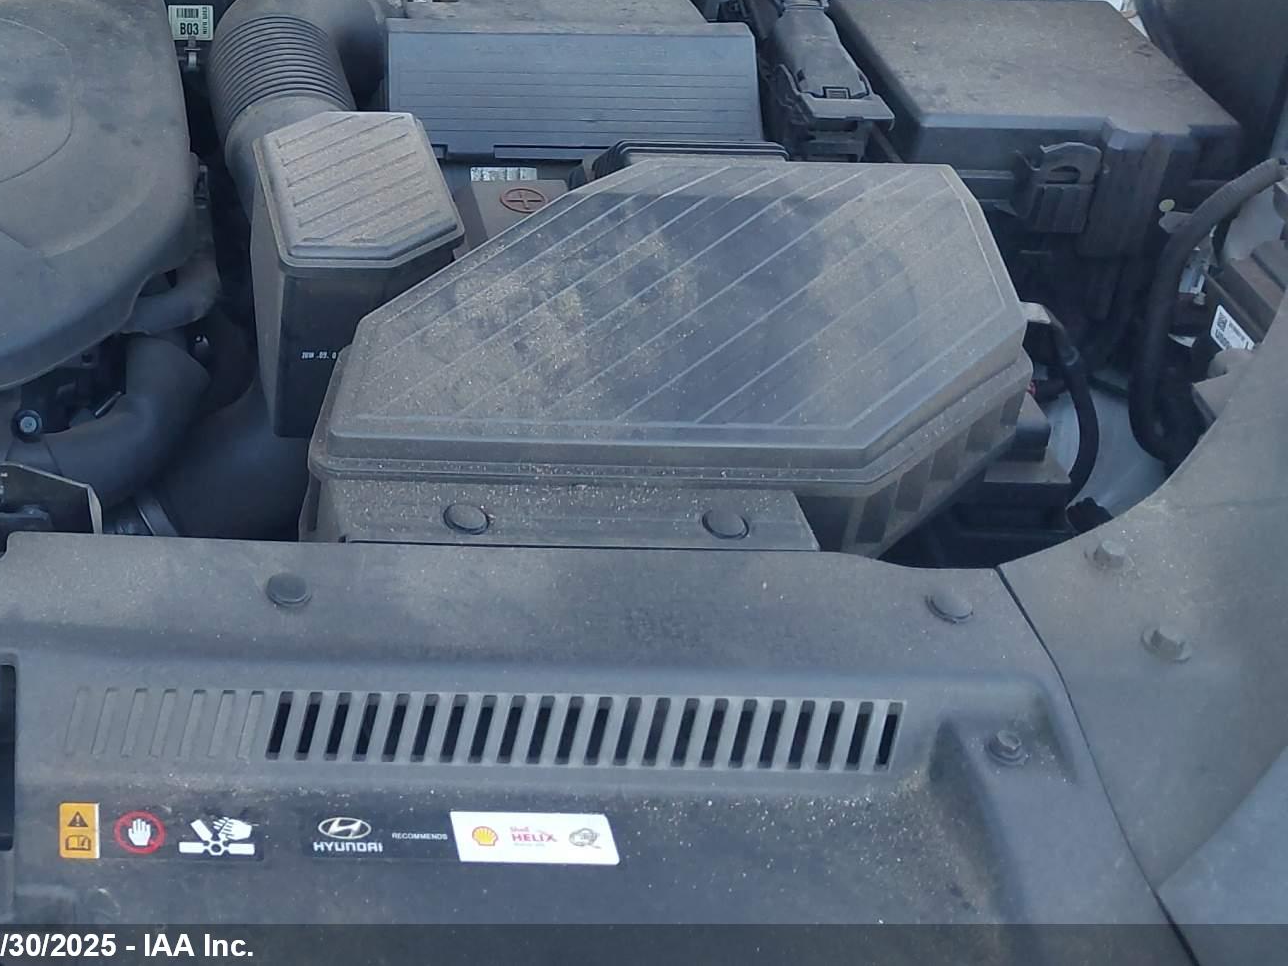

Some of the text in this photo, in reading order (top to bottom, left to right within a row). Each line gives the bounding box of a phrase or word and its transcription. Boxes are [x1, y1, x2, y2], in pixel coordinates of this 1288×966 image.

[180, 22, 199, 35] B03
[391, 832, 449, 840] RECOMMENDS
[512, 833, 556, 843] HELIX
[313, 841, 383, 852] HYUNDAI
